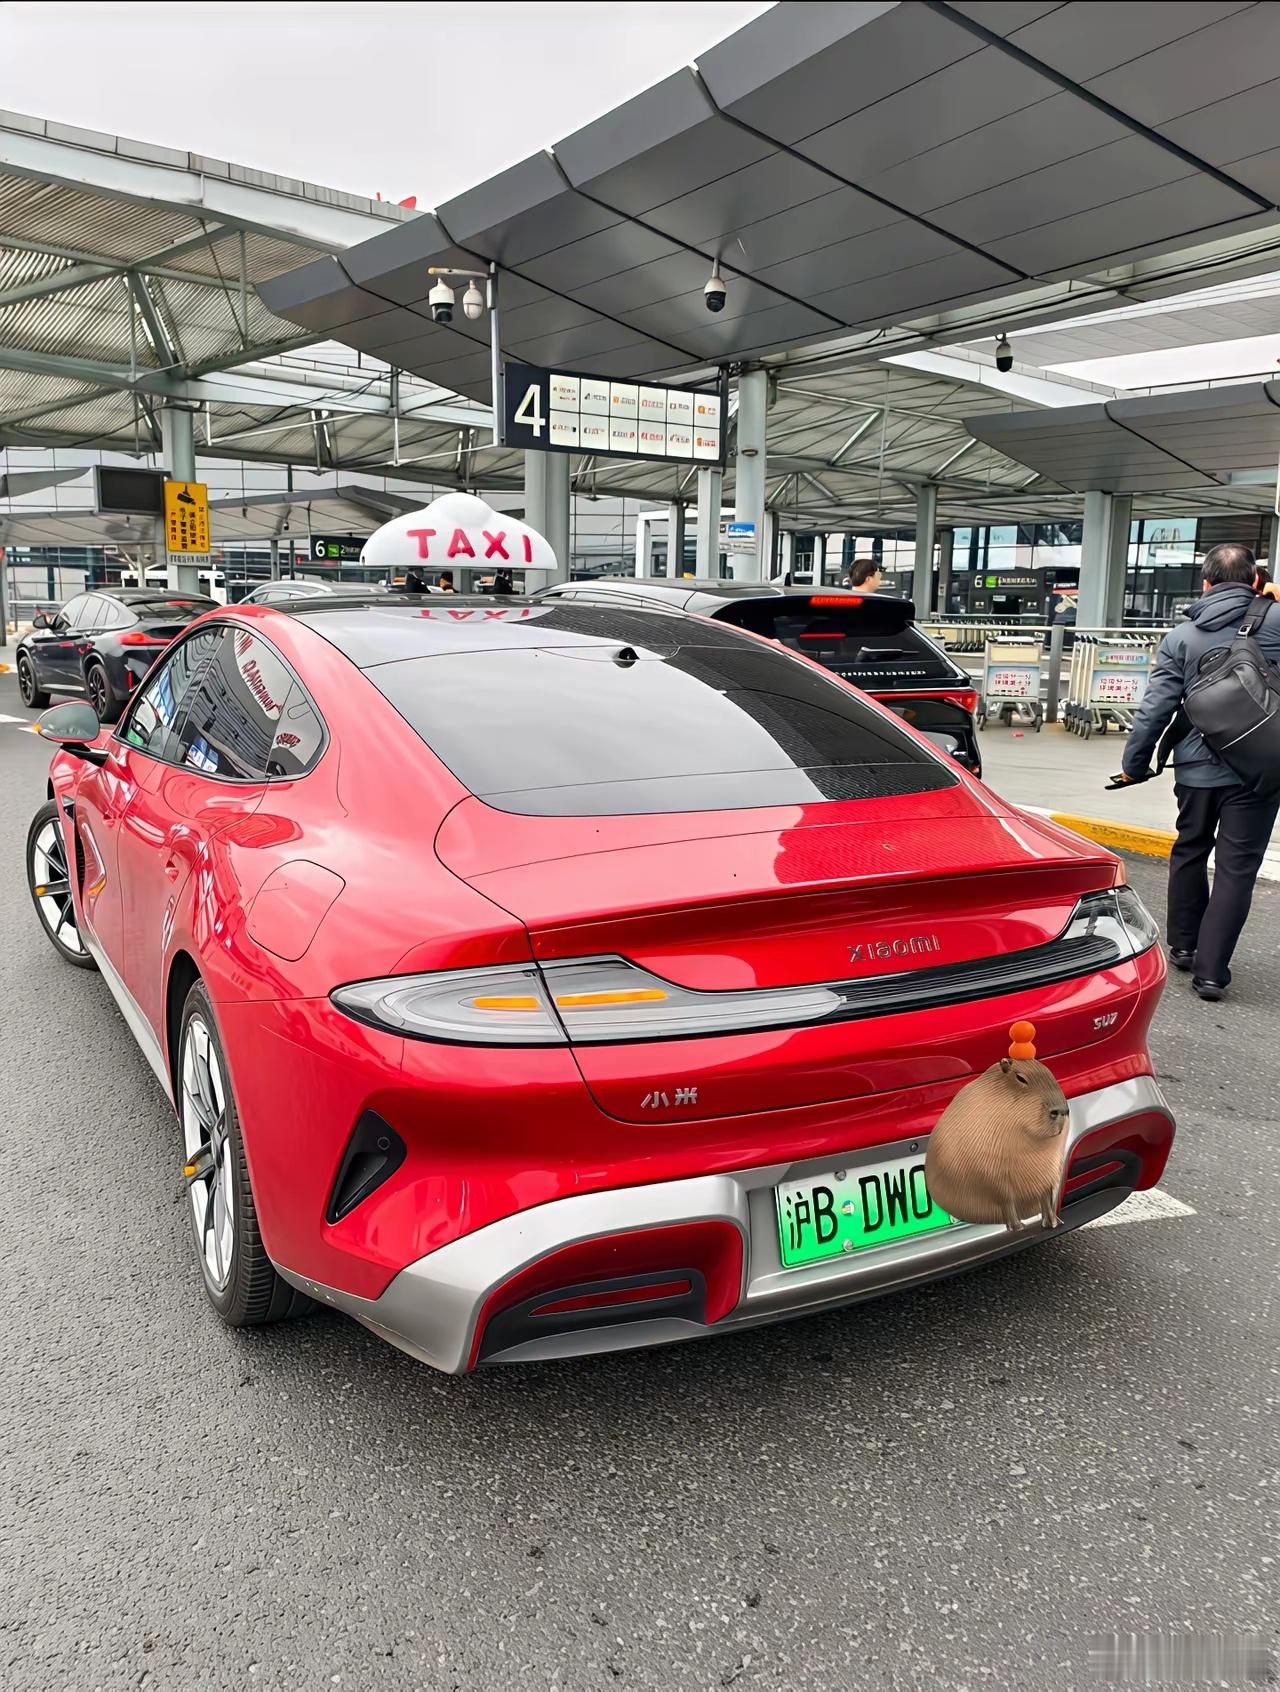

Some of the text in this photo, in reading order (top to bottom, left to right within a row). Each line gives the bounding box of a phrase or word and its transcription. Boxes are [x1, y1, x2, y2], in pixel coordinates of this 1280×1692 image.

[514, 384, 546, 437] 4
[315, 540, 326, 557] 6
[406, 528, 533, 563] TAXI
[974, 575, 983, 588] 6
[847, 934, 941, 963] xiaomi
[1093, 1012, 1118, 1030] SU7
[640, 1087, 698, 1109] 小米
